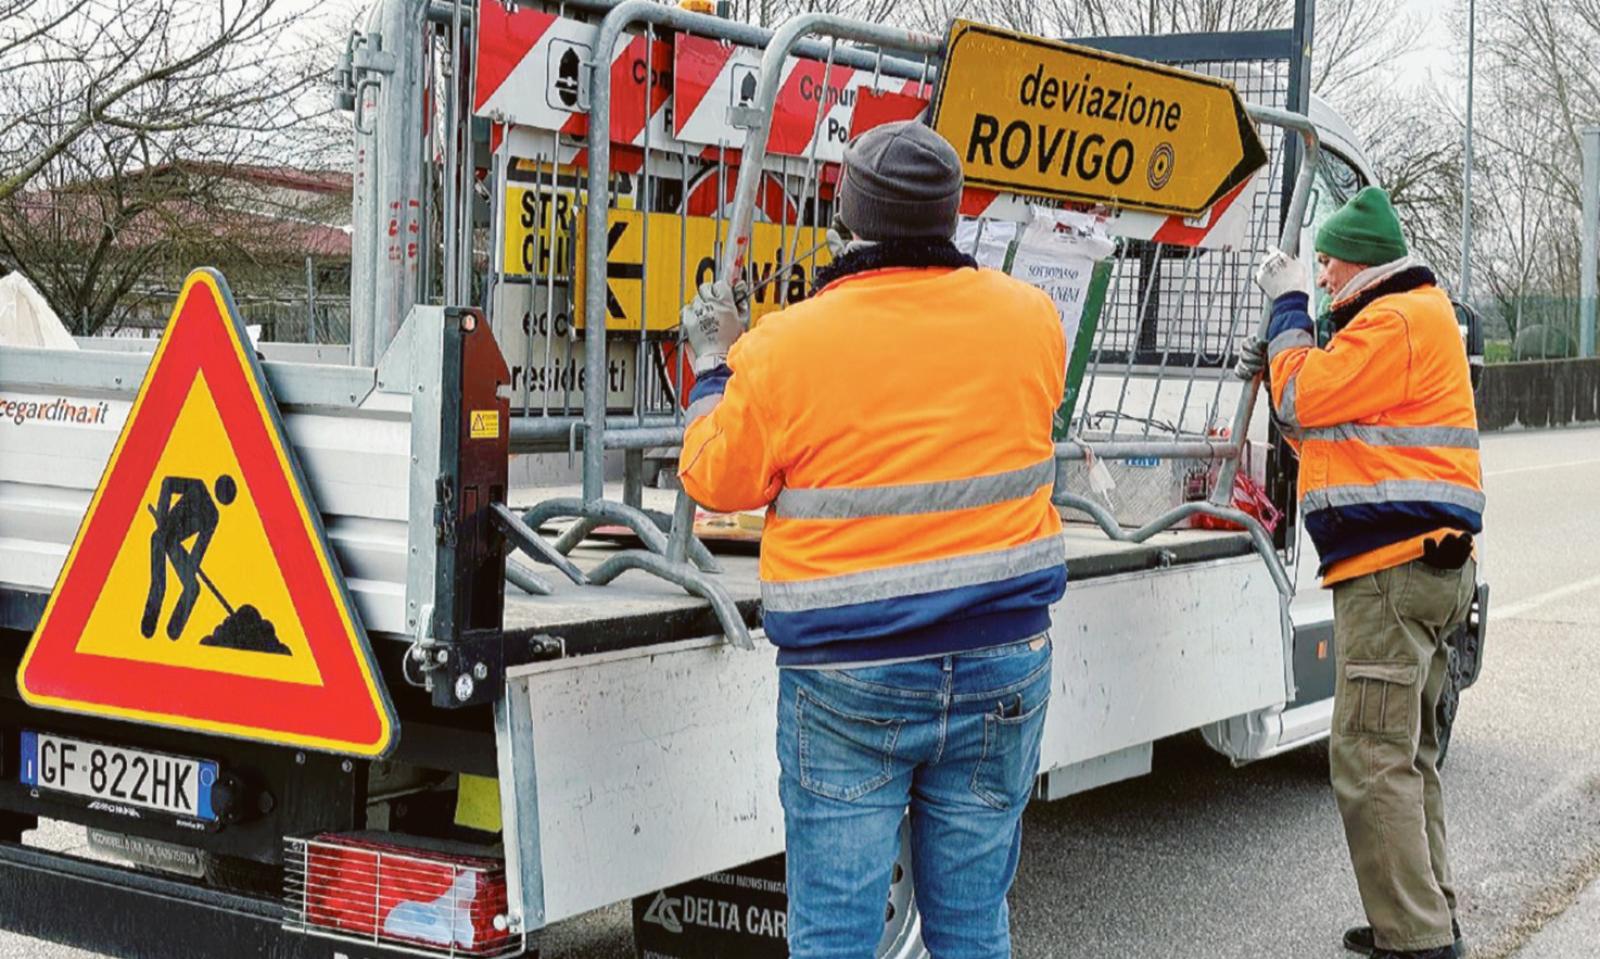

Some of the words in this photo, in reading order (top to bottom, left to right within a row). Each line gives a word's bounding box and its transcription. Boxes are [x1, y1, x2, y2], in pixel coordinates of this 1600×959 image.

[1020, 64, 1182, 132] deviazione
[966, 113, 1134, 185] ROVIGO
[682, 895, 741, 933] DELTA
